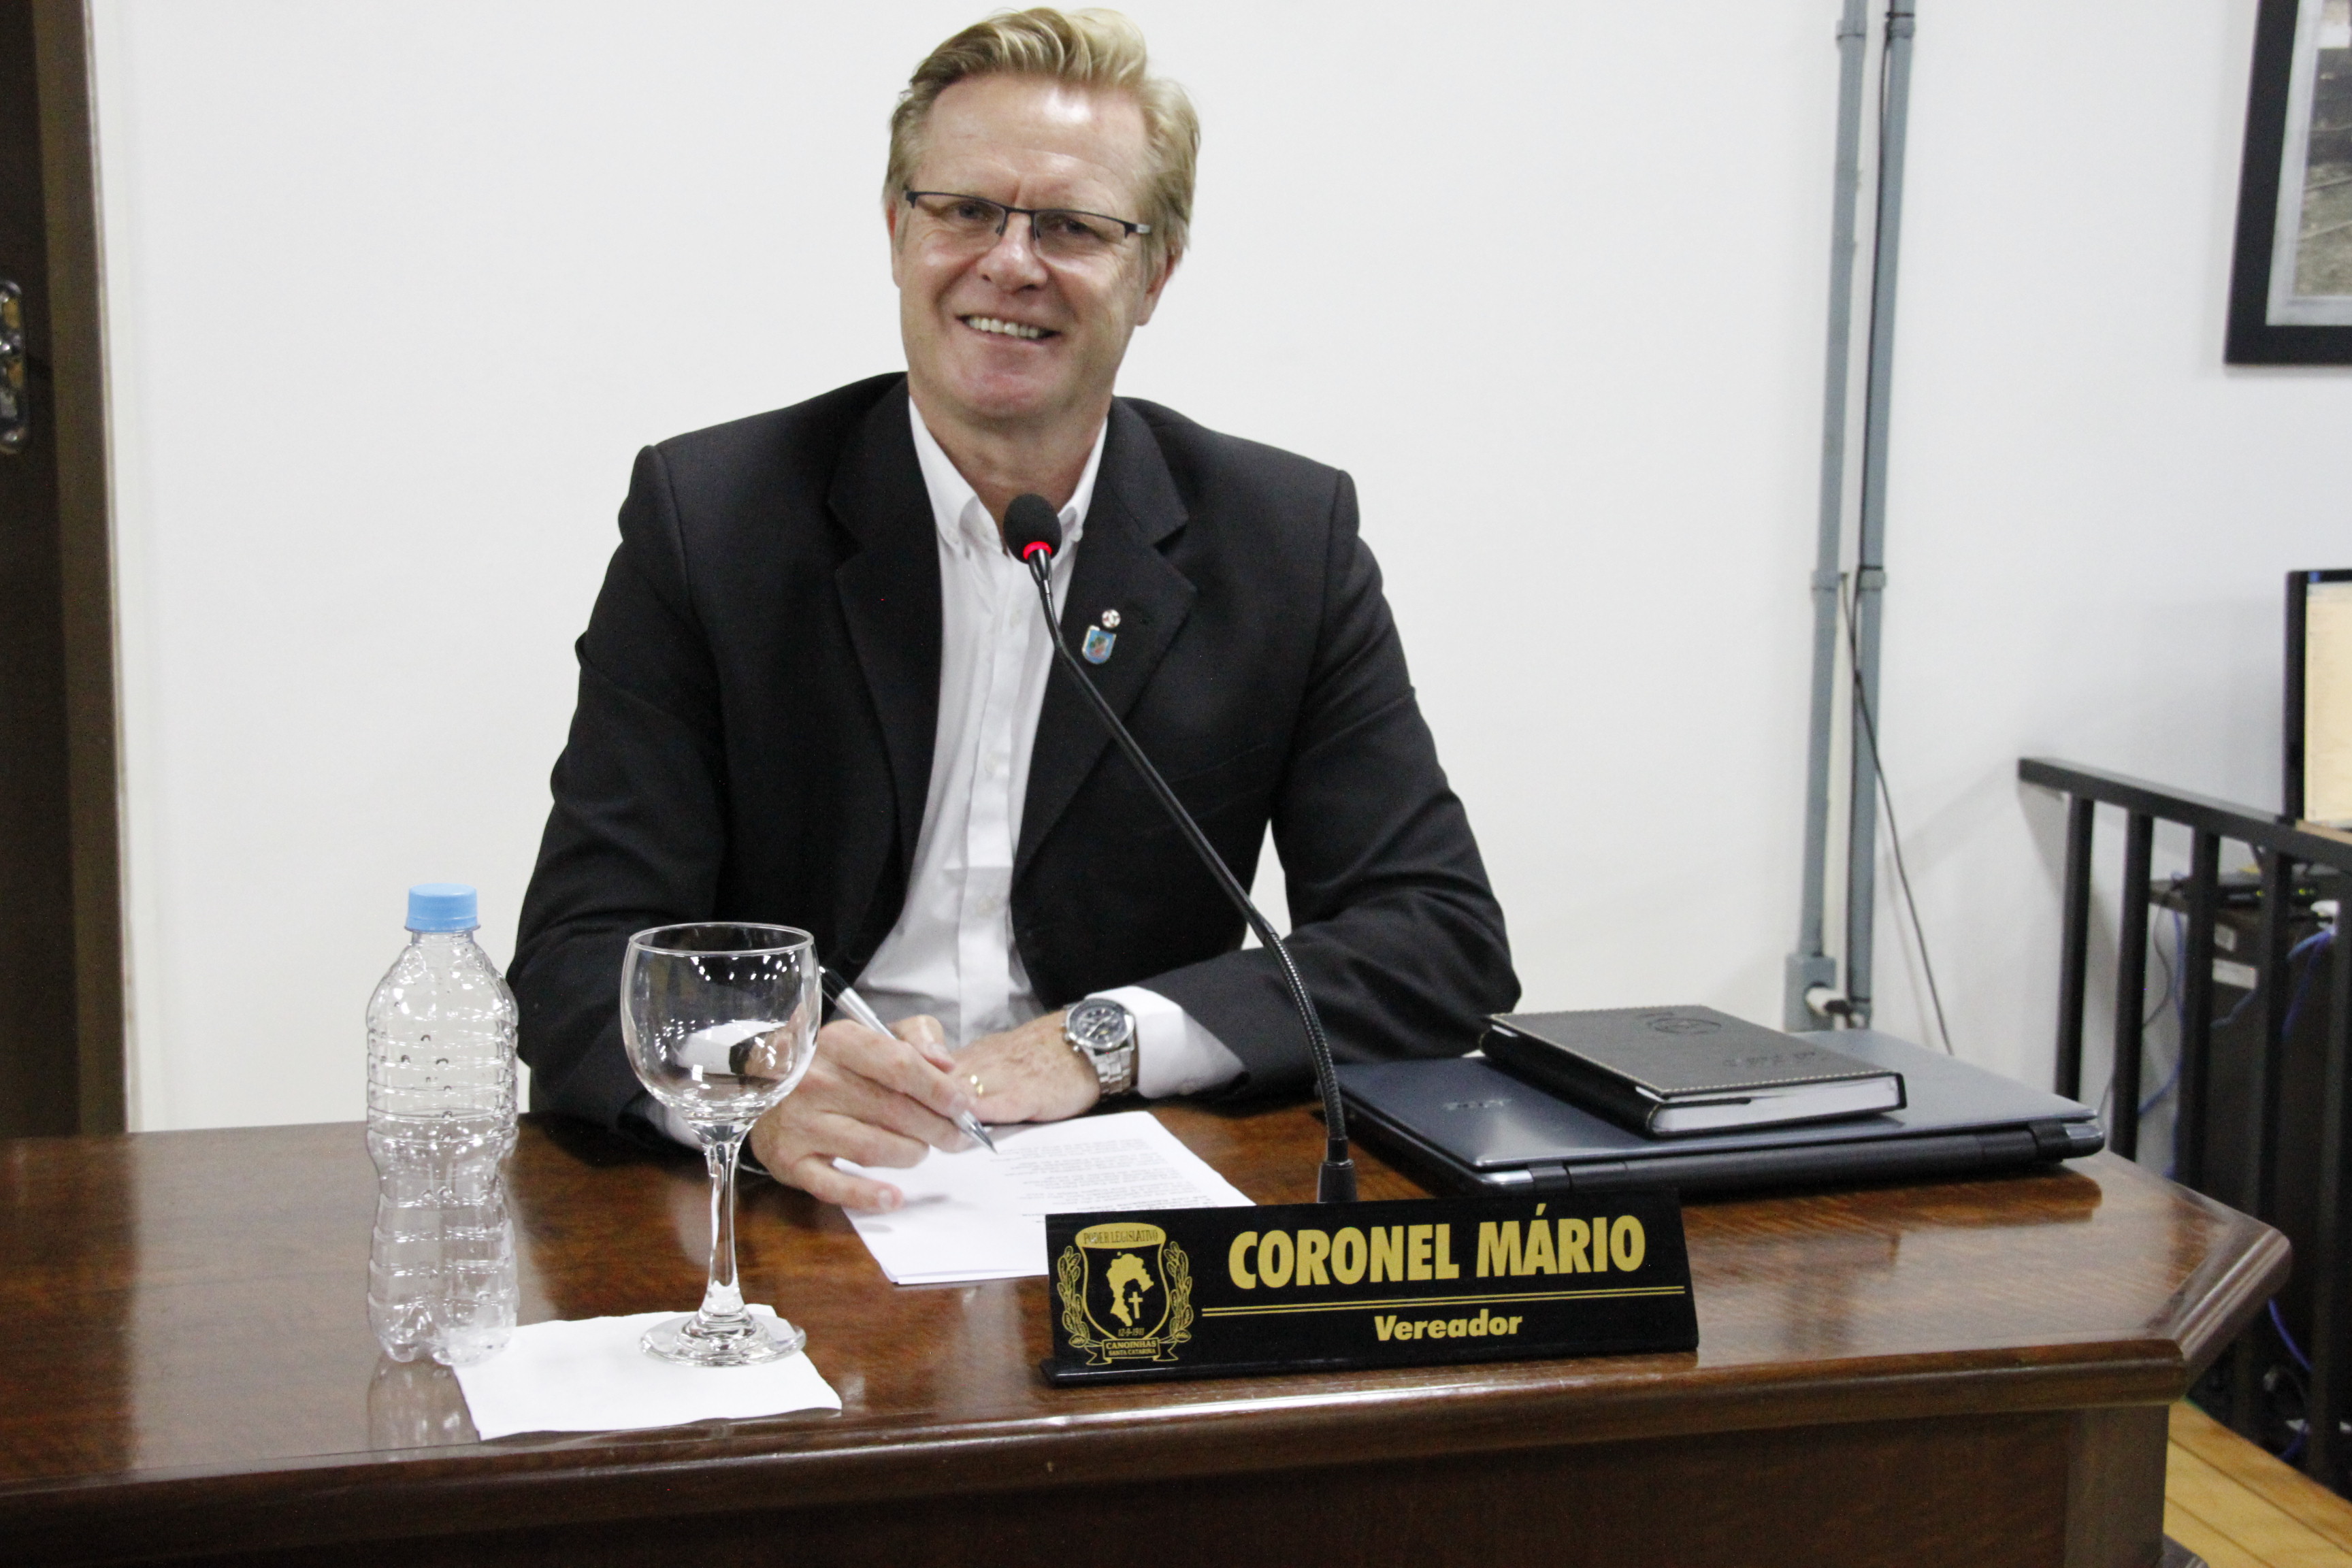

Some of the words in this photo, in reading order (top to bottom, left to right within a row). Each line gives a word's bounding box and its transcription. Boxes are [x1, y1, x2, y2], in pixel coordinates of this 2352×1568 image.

[1083, 1232, 1110, 1245] PODER
[1111, 1229, 1158, 1243] LEGISLATIVO
[1228, 1224, 1459, 1290] CORONEL
[1475, 1203, 1646, 1278] MÁRIO
[1373, 1308, 1523, 1341] Vereador
[1105, 1340, 1157, 1350] CANOINHAS
